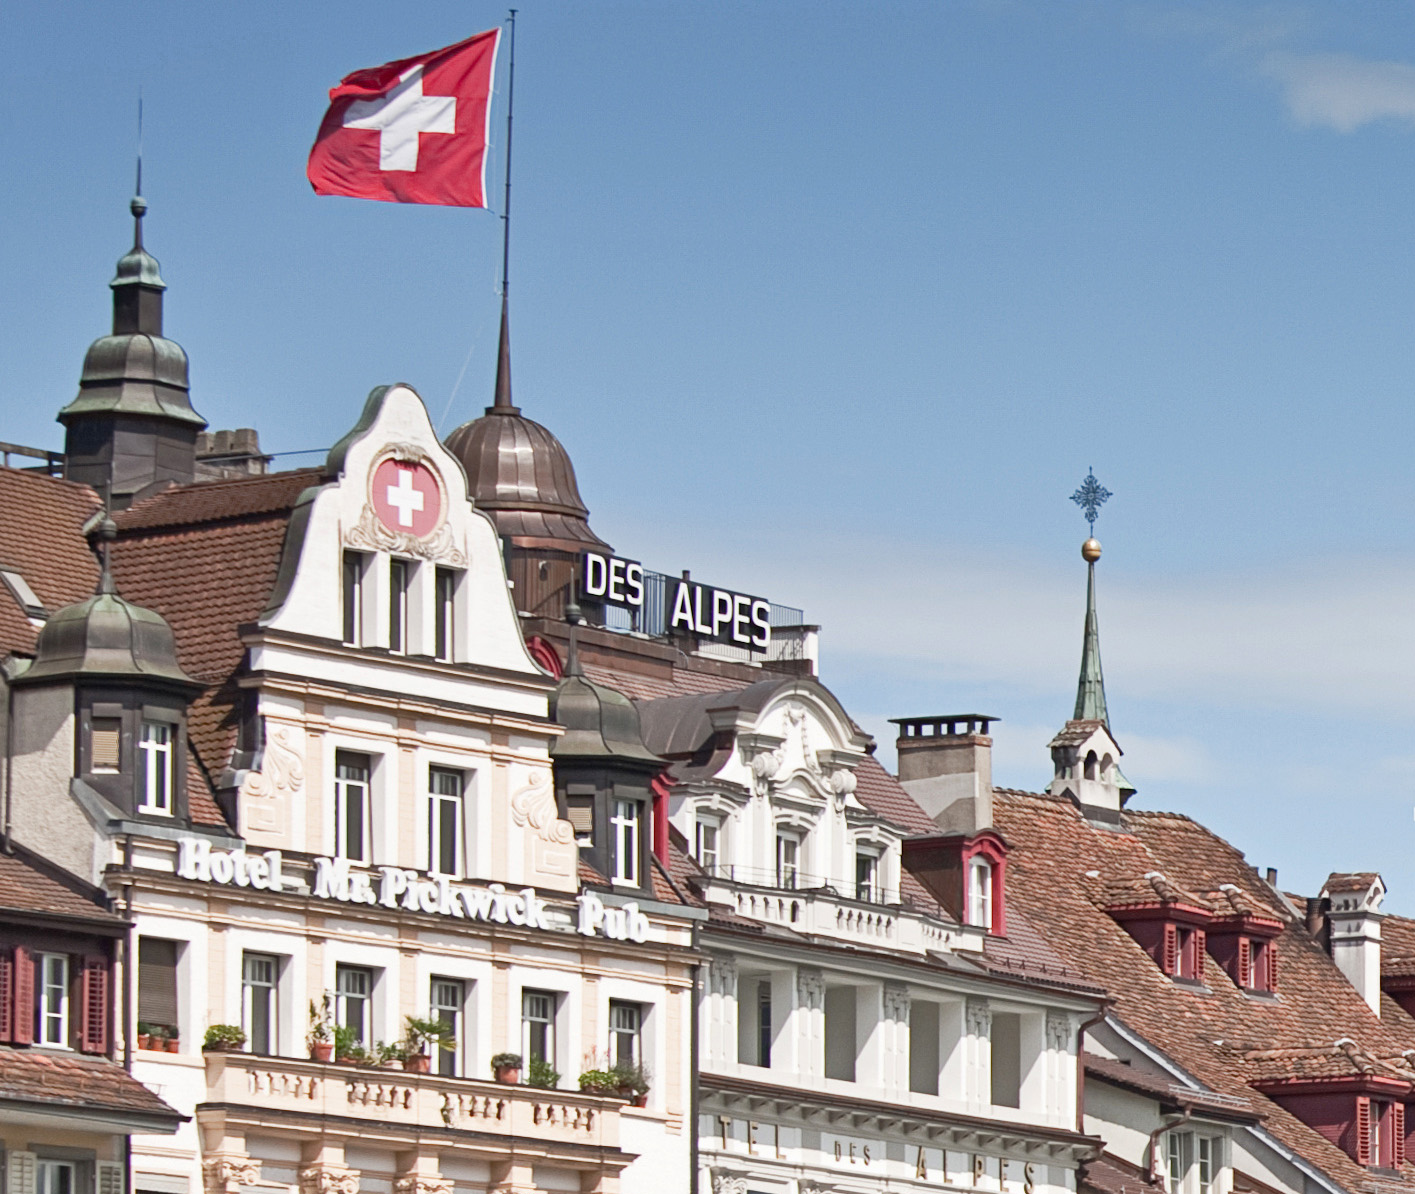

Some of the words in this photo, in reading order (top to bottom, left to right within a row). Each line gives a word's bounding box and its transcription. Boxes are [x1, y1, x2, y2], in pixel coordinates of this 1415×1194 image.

[586, 552, 644, 606] DES
[671, 581, 771, 647] ALPES
[177, 837, 283, 892] Hotel
[576, 896, 650, 943] Pub
[834, 1140, 871, 1166] DES
